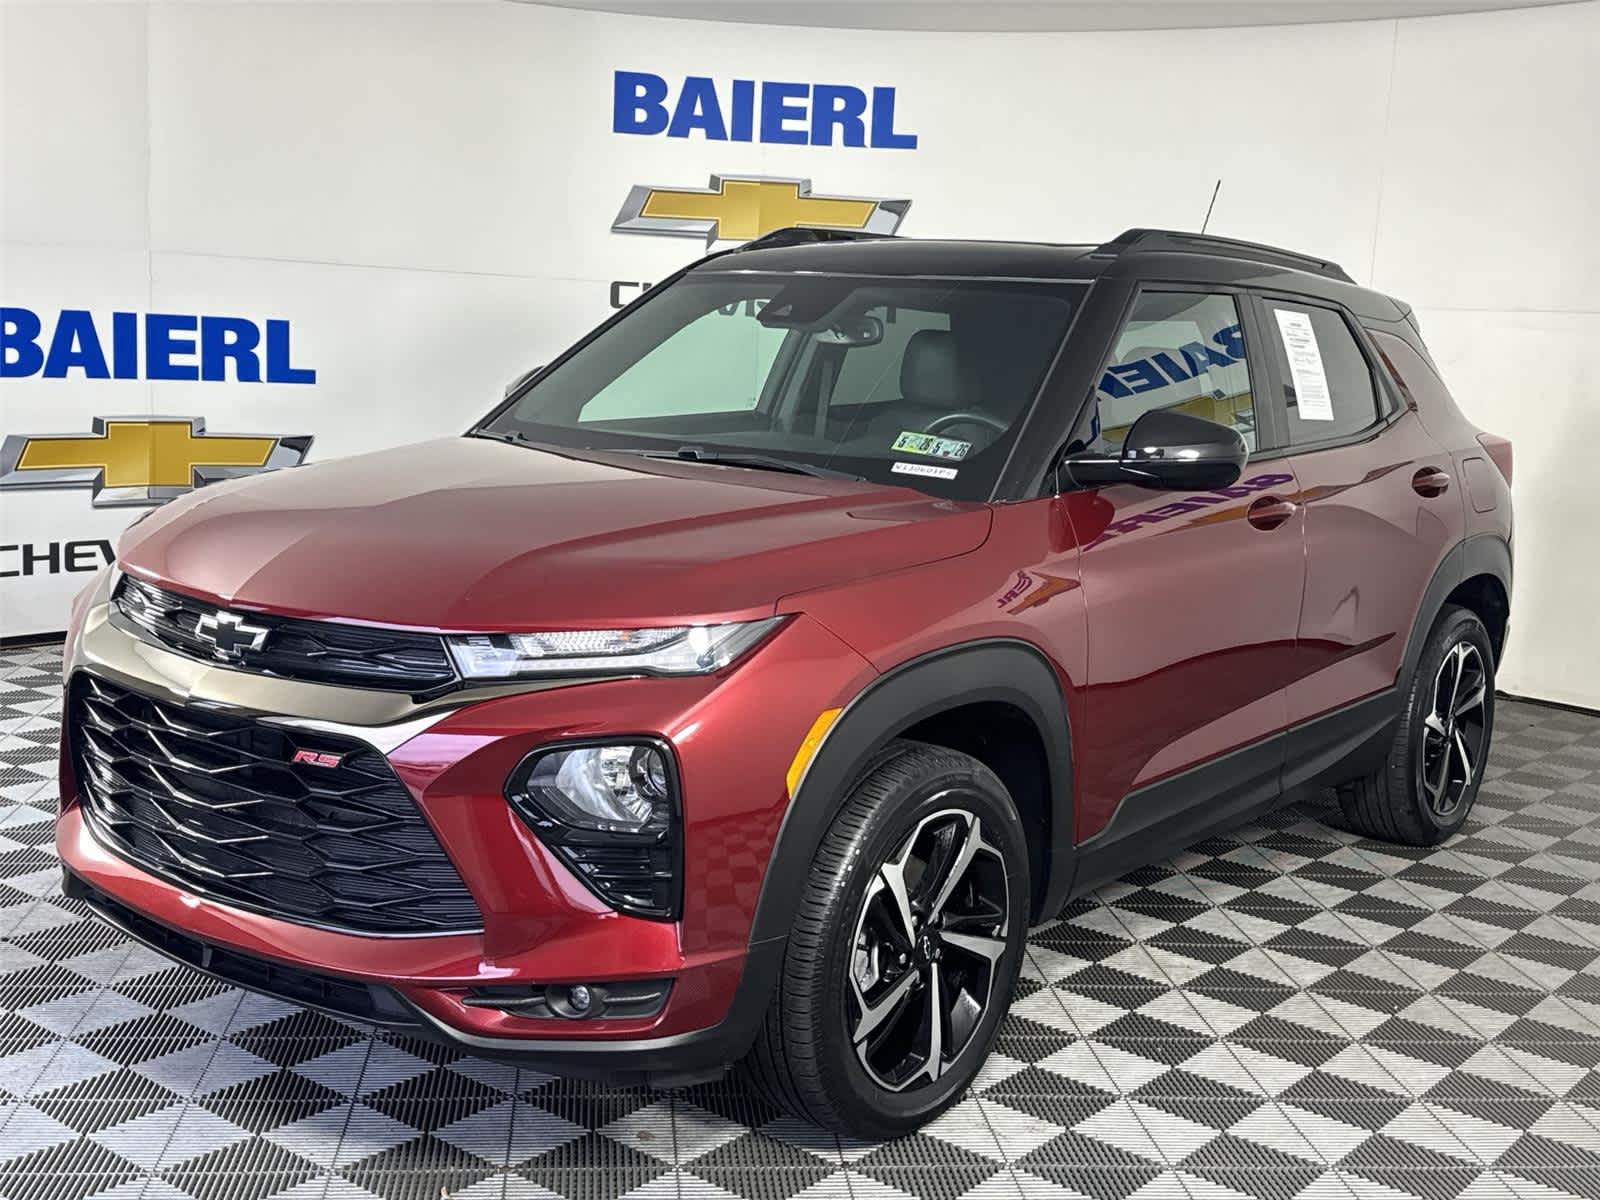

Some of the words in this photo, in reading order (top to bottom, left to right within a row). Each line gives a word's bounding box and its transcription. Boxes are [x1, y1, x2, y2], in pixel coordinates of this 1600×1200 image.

[612, 70, 918, 150] BAIERL
[0, 307, 317, 385] BAIERL
[292, 750, 342, 768] RS
